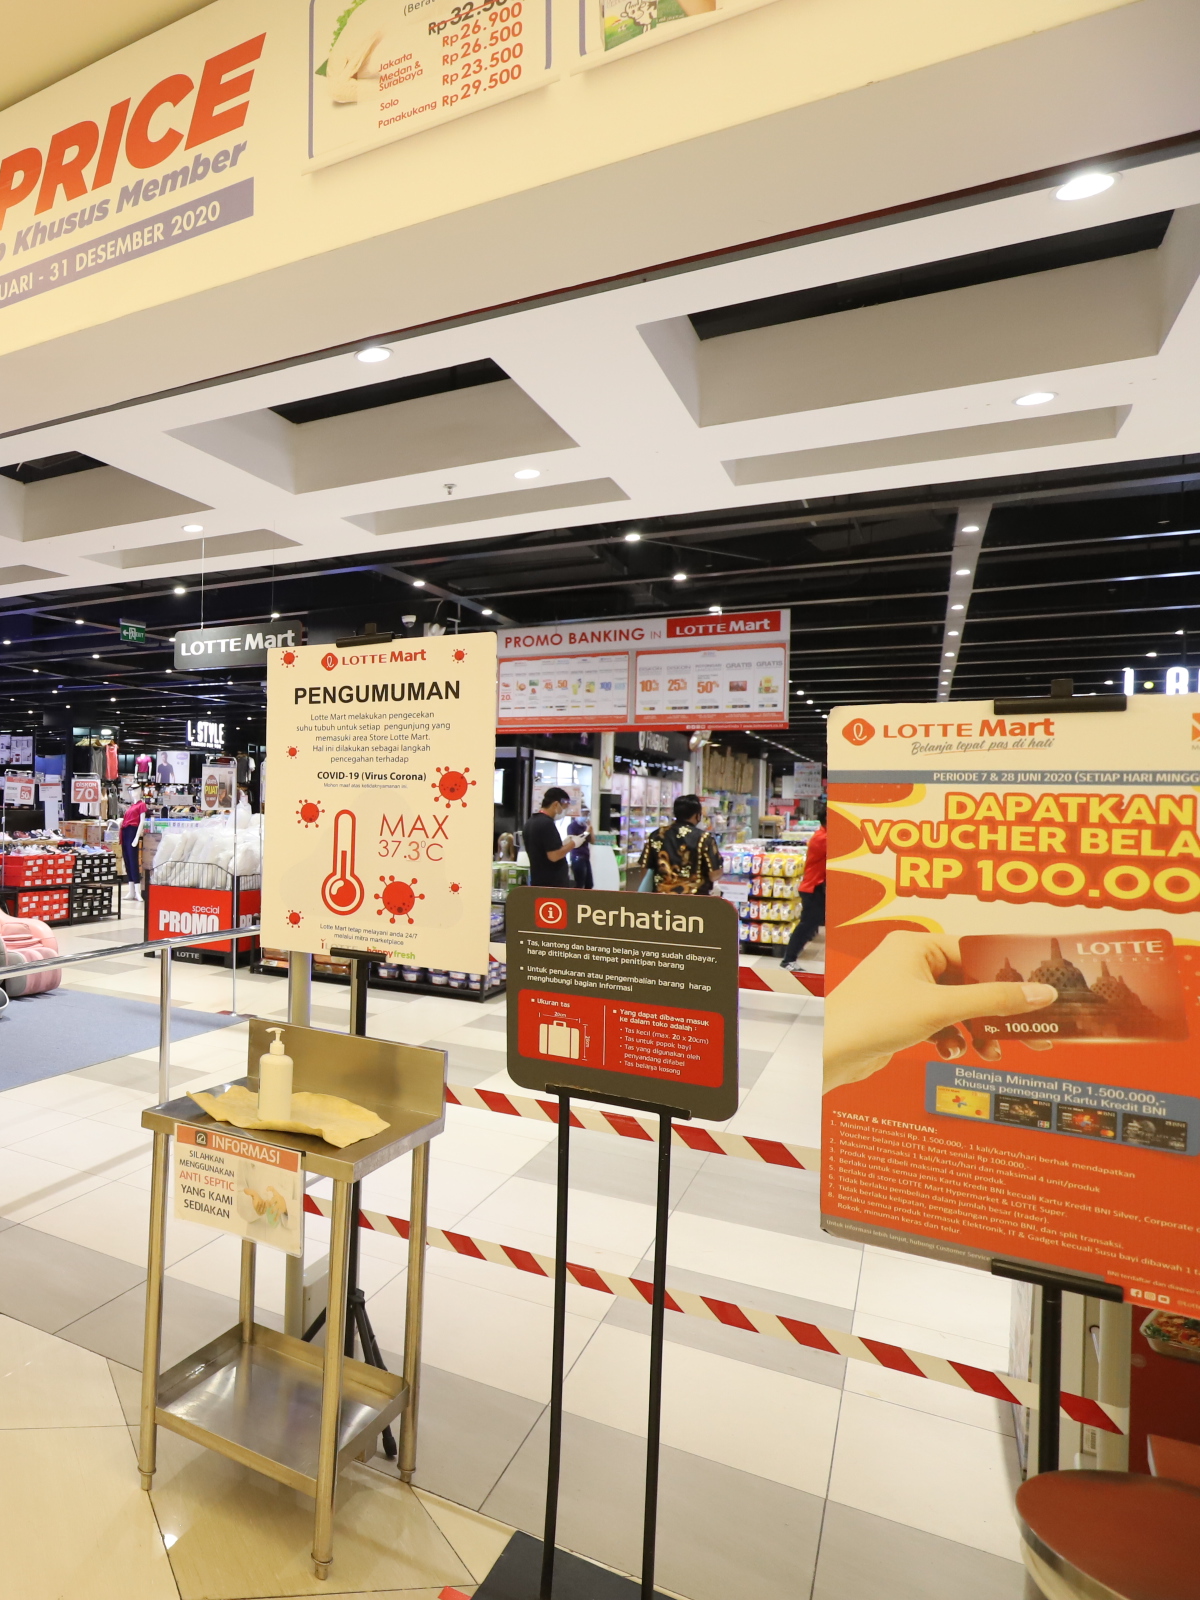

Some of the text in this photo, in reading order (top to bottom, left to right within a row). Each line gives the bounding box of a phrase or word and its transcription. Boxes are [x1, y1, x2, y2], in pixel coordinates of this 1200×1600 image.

[379, 53, 412, 72] Jakarta
[379, 65, 411, 83] Medan
[414, 61, 421, 69] &
[379, 68, 423, 91] Surabaya
[378, 100, 437, 128] Panakukang
[380, 99, 399, 111] Solo
[12, 198, 111, 256] Khusus
[116, 141, 247, 214] Member
[50, 259, 68, 282] 31
[76, 223, 164, 272] DESEMBER
[171, 201, 220, 236] 2020
[181, 630, 295, 656] LOTTE Mart
[505, 619, 770, 648] PROMO BANKING IN LOTTE Mart
[342, 649, 426, 665] LOTTE Mart
[295, 681, 460, 705] PENGUMUMAN
[389, 711, 434, 720] pengecekan
[359, 724, 380, 732] setiap
[384, 723, 429, 731] pengunjung
[883, 718, 1055, 738] LOTTE Mart
[371, 745, 399, 753] sebagai
[401, 745, 430, 753] langkah
[911, 738, 1055, 755] Belanja tepat pas di hati
[331, 756, 374, 764] pencegahan
[362, 772, 388, 780] (Virus
[390, 772, 426, 781] Corona)
[934, 772, 978, 781] PERIODE
[990, 773, 998, 781] &
[1001, 773, 1014, 781] 28
[1017, 773, 1041, 782] JUNI
[1044, 772, 1072, 782] 2020
[1074, 771, 1120, 784] (SETIAP
[1123, 773, 1152, 783] HARI
[1156, 773, 1200, 784] MINGG
[947, 795, 1194, 825] DAPATKAN
[380, 813, 449, 839] MAX
[863, 822, 1067, 853] VOUCHER
[900, 857, 963, 889] RP
[192, 905, 219, 914] special
[577, 904, 704, 934] Perhatian
[159, 910, 219, 935] PROMO
[177, 951, 199, 959] LOTTE
[542, 941, 569, 950] kantong
[586, 945, 610, 954] barang
[613, 947, 639, 956] belanja
[641, 951, 659, 959] yang
[662, 951, 683, 960] sudah
[1076, 941, 1163, 955] LOTTE
[527, 948, 546, 956] harap
[548, 950, 581, 960] dititipkan
[592, 954, 618, 964] tempat
[621, 957, 656, 967] penitipan
[658, 960, 684, 971] barang
[984, 1023, 1058, 1034] Rp. 100.000
[955, 1068, 1165, 1105] Belanja Minimal Rp 1.500.000,-
[955, 1078, 1167, 1116] Khusus pemegang Kartu Kredit BNI
[881, 1118, 938, 1134] KETENTUAN:
[189, 1150, 224, 1164] SILAHKAN
[212, 1135, 280, 1164] INFORMASI
[180, 1159, 234, 1178] MENGGUNAKAN
[180, 1170, 234, 1191] ANTI SEPTIC
[181, 1184, 233, 1205] YANG KAMI
[184, 1199, 230, 1219] SEDIAKAN
